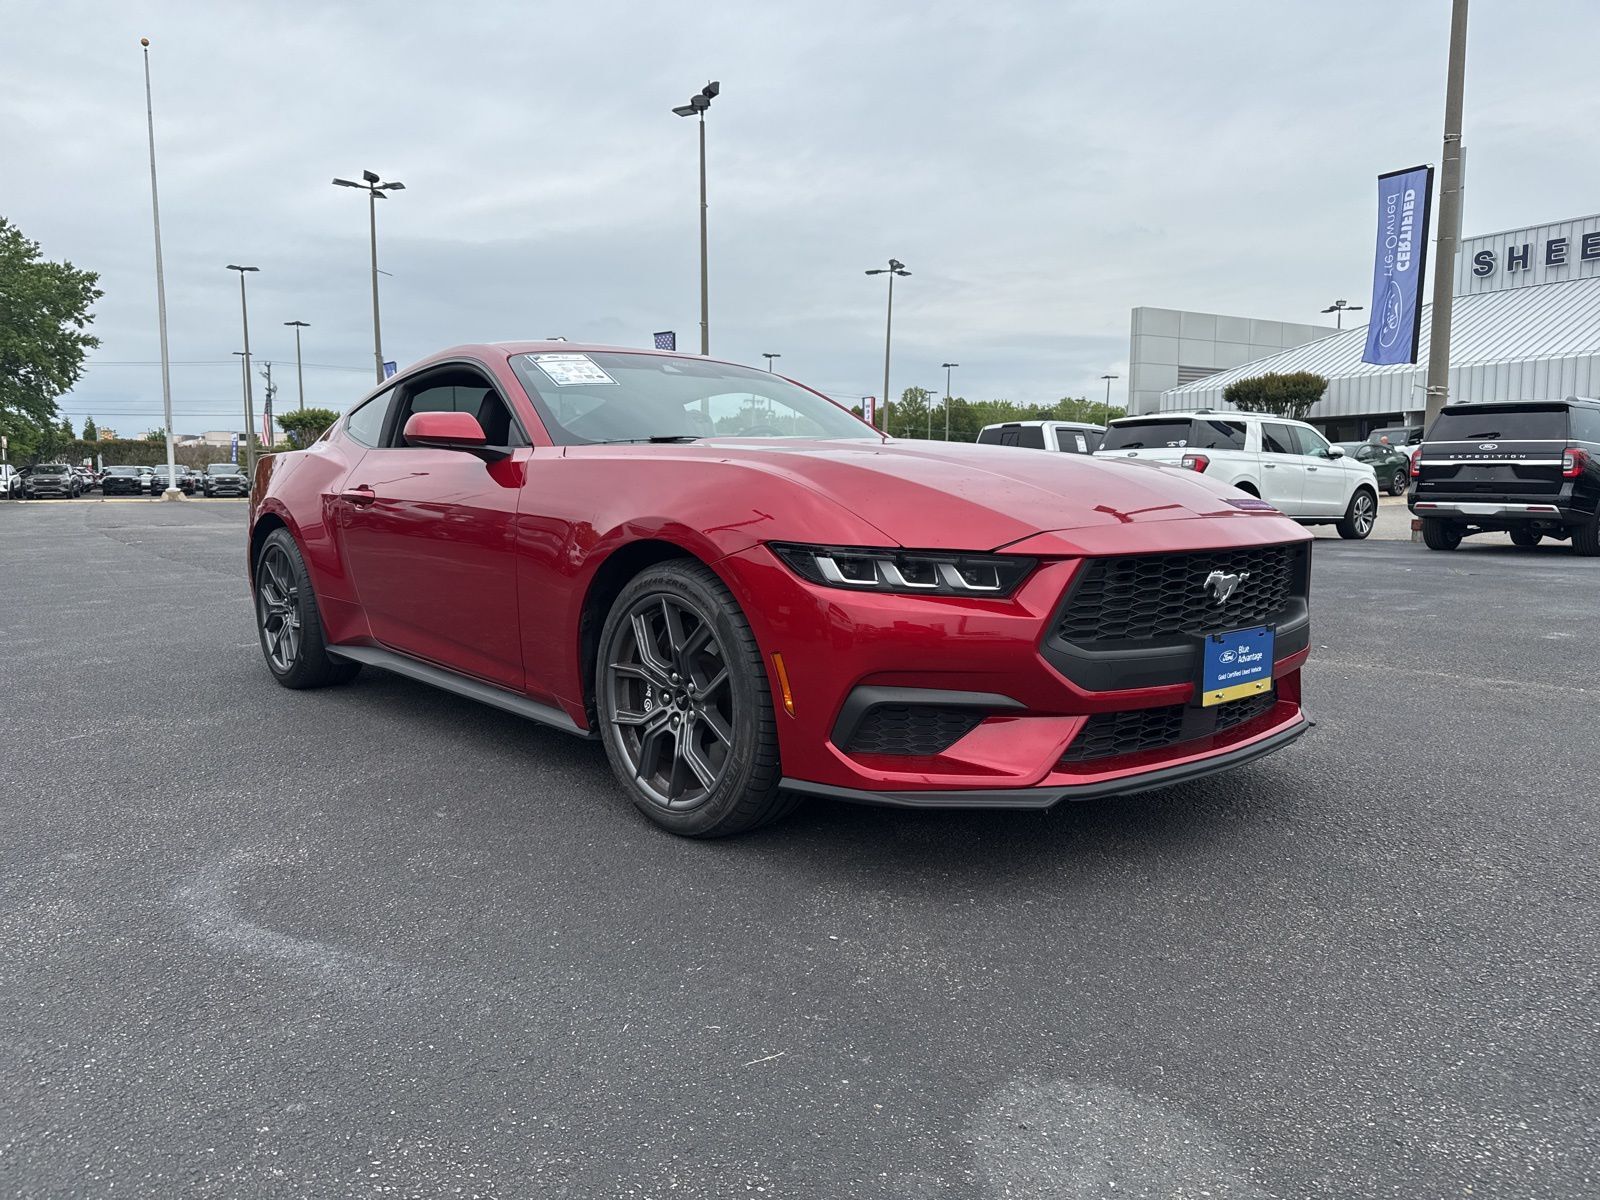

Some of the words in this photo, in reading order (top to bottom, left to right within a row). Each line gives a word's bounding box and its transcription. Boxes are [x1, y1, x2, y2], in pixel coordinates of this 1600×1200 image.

[1473, 231, 1600, 277] SHEE
[1238, 646, 1250, 654] Blue
[1238, 652, 1262, 663] Advantage
